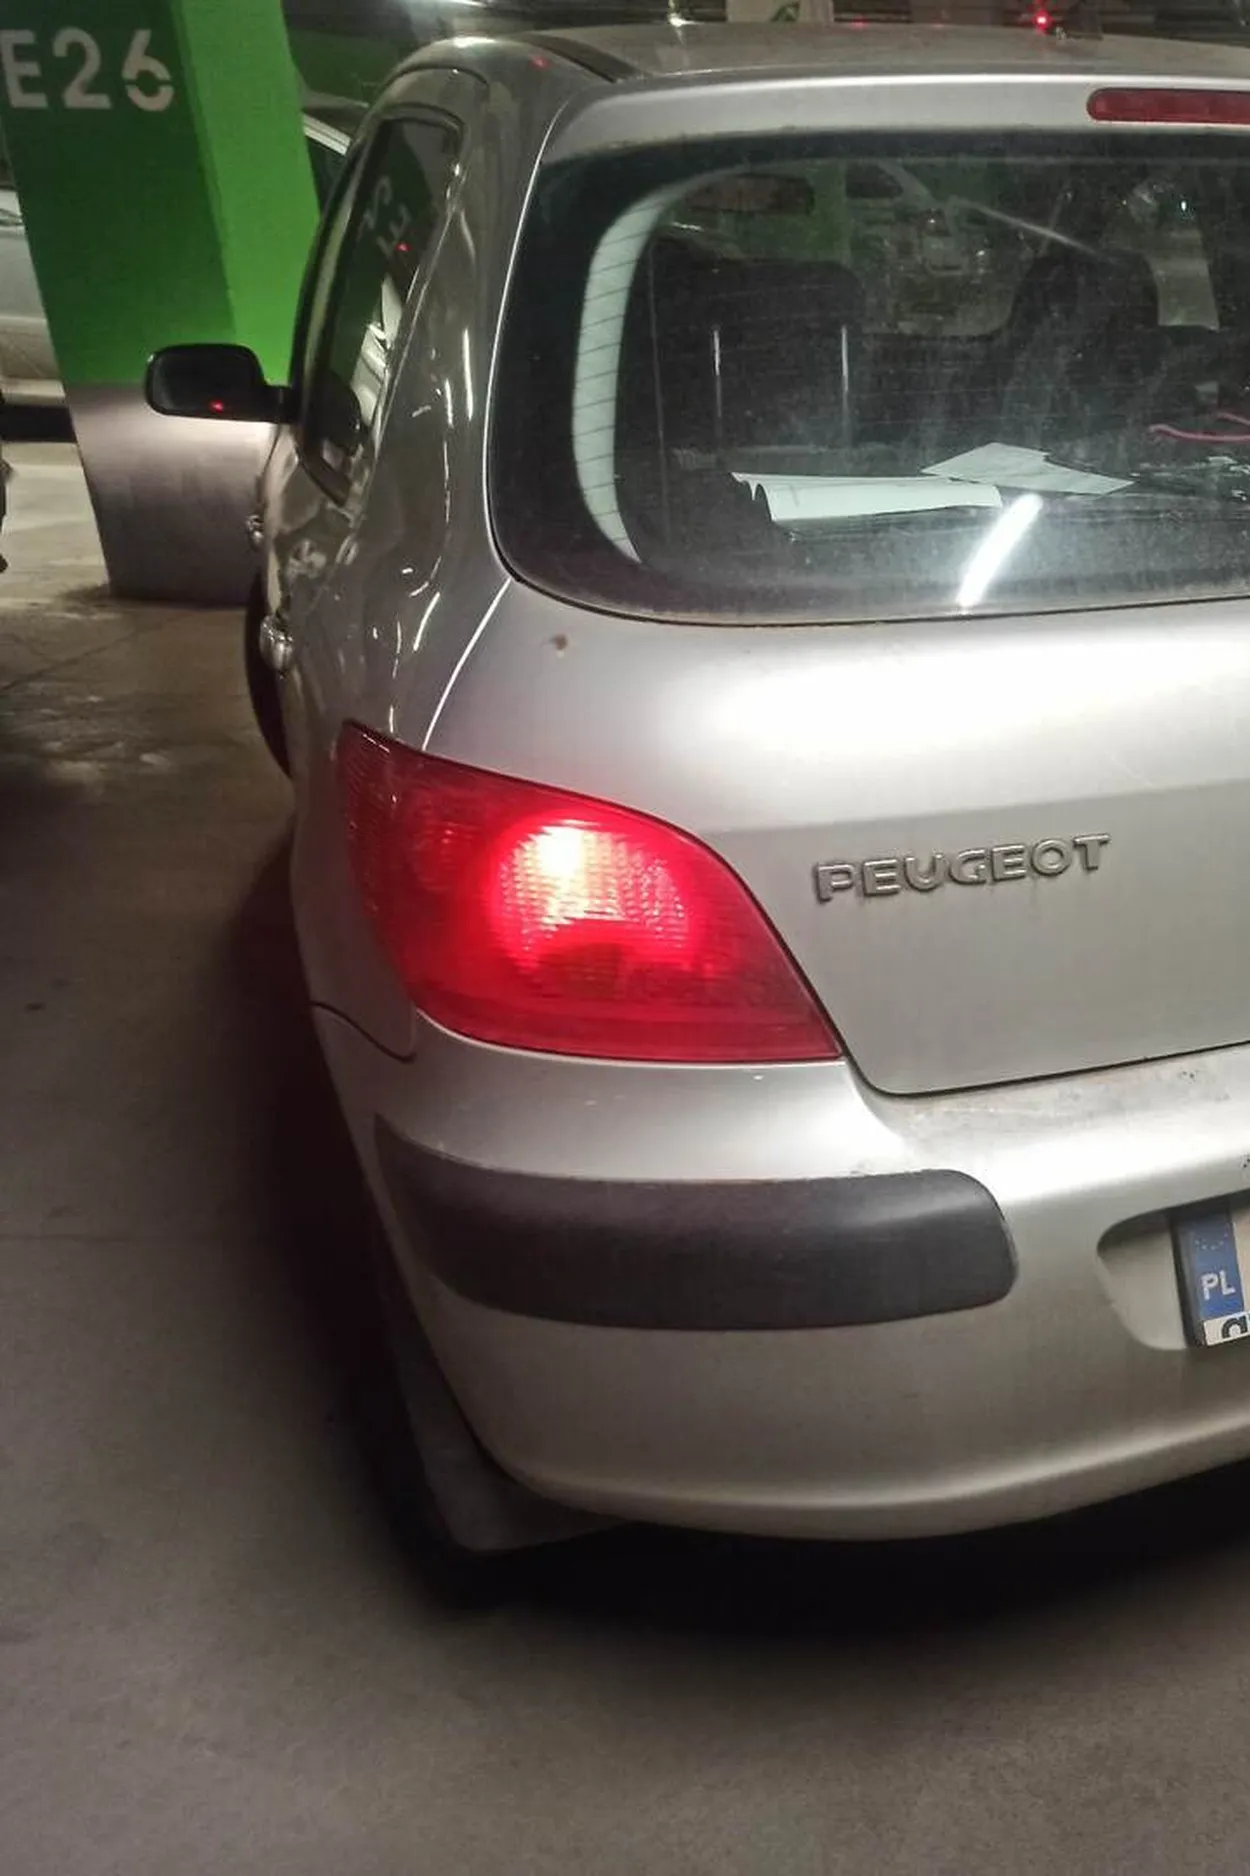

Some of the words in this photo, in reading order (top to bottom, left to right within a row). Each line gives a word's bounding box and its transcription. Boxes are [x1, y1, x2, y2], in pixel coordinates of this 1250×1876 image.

[0, 26, 175, 112] E26
[812, 832, 1112, 904] PEUGEOT
[1201, 1270, 1236, 1300] PL
